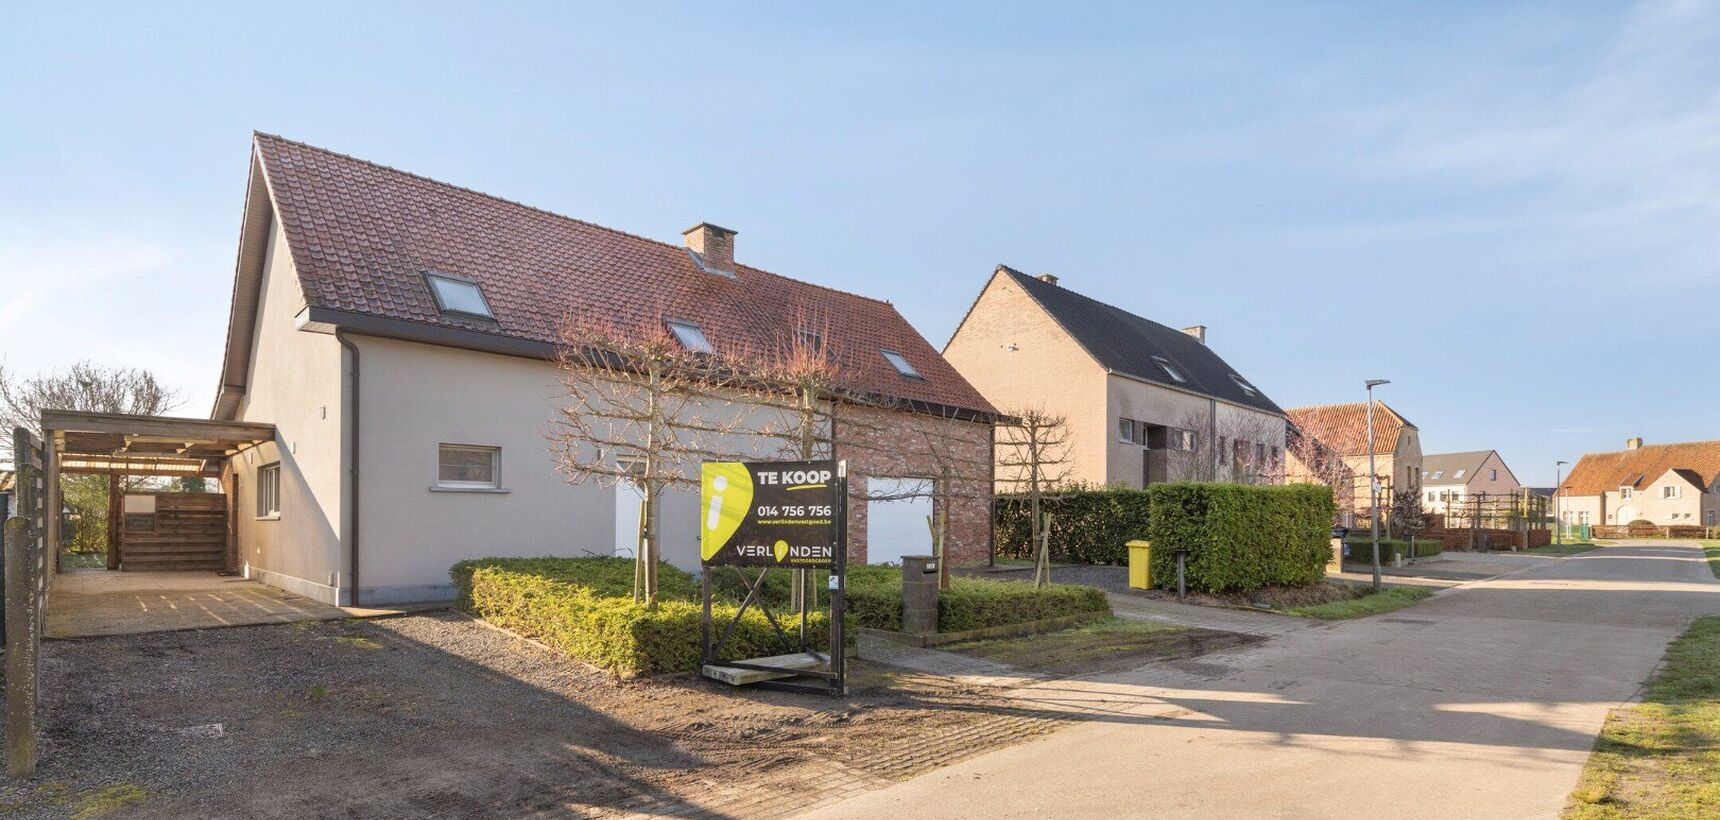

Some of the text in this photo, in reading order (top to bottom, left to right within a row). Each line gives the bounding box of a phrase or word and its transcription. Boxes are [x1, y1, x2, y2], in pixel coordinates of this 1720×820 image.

[757, 470, 832, 485] TE KOOP
[757, 505, 832, 517] 014 756 756
